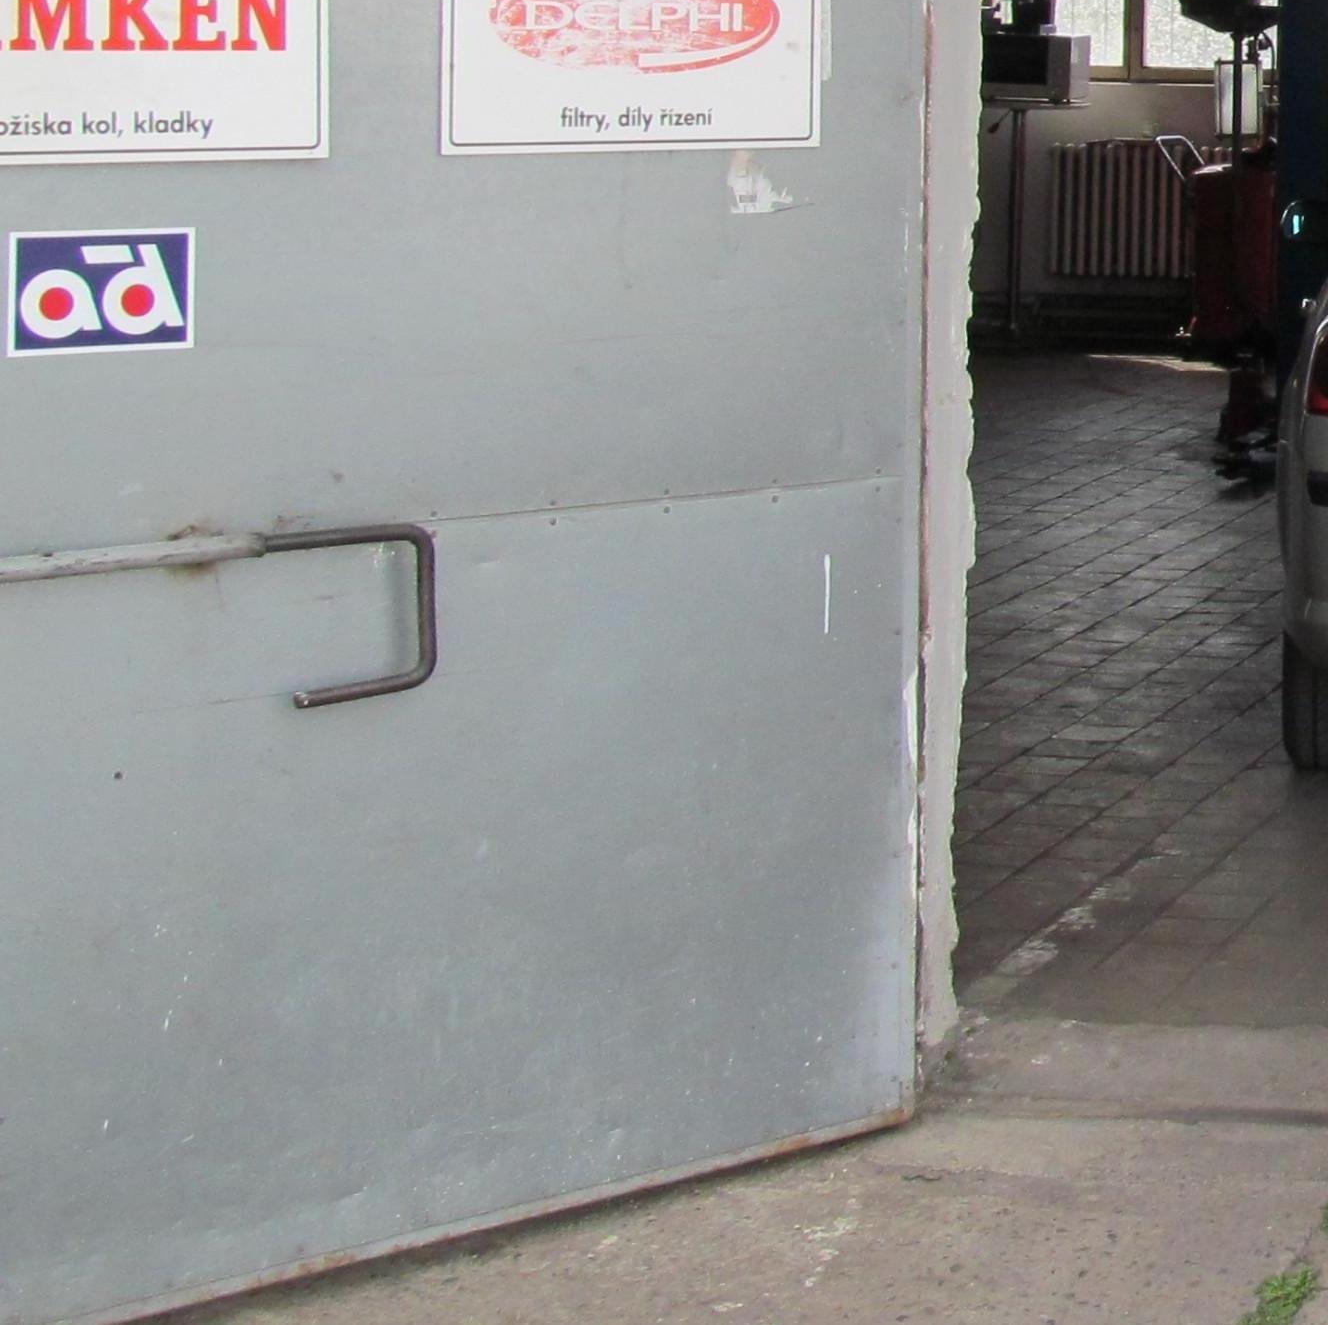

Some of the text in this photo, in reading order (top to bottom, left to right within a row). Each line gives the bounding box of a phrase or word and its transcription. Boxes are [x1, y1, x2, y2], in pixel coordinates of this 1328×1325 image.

[514, 1, 745, 32] DELPHI
[82, 111, 124, 139] kol,
[133, 110, 214, 140] kladky
[560, 106, 713, 133] filtry, díly řízení
